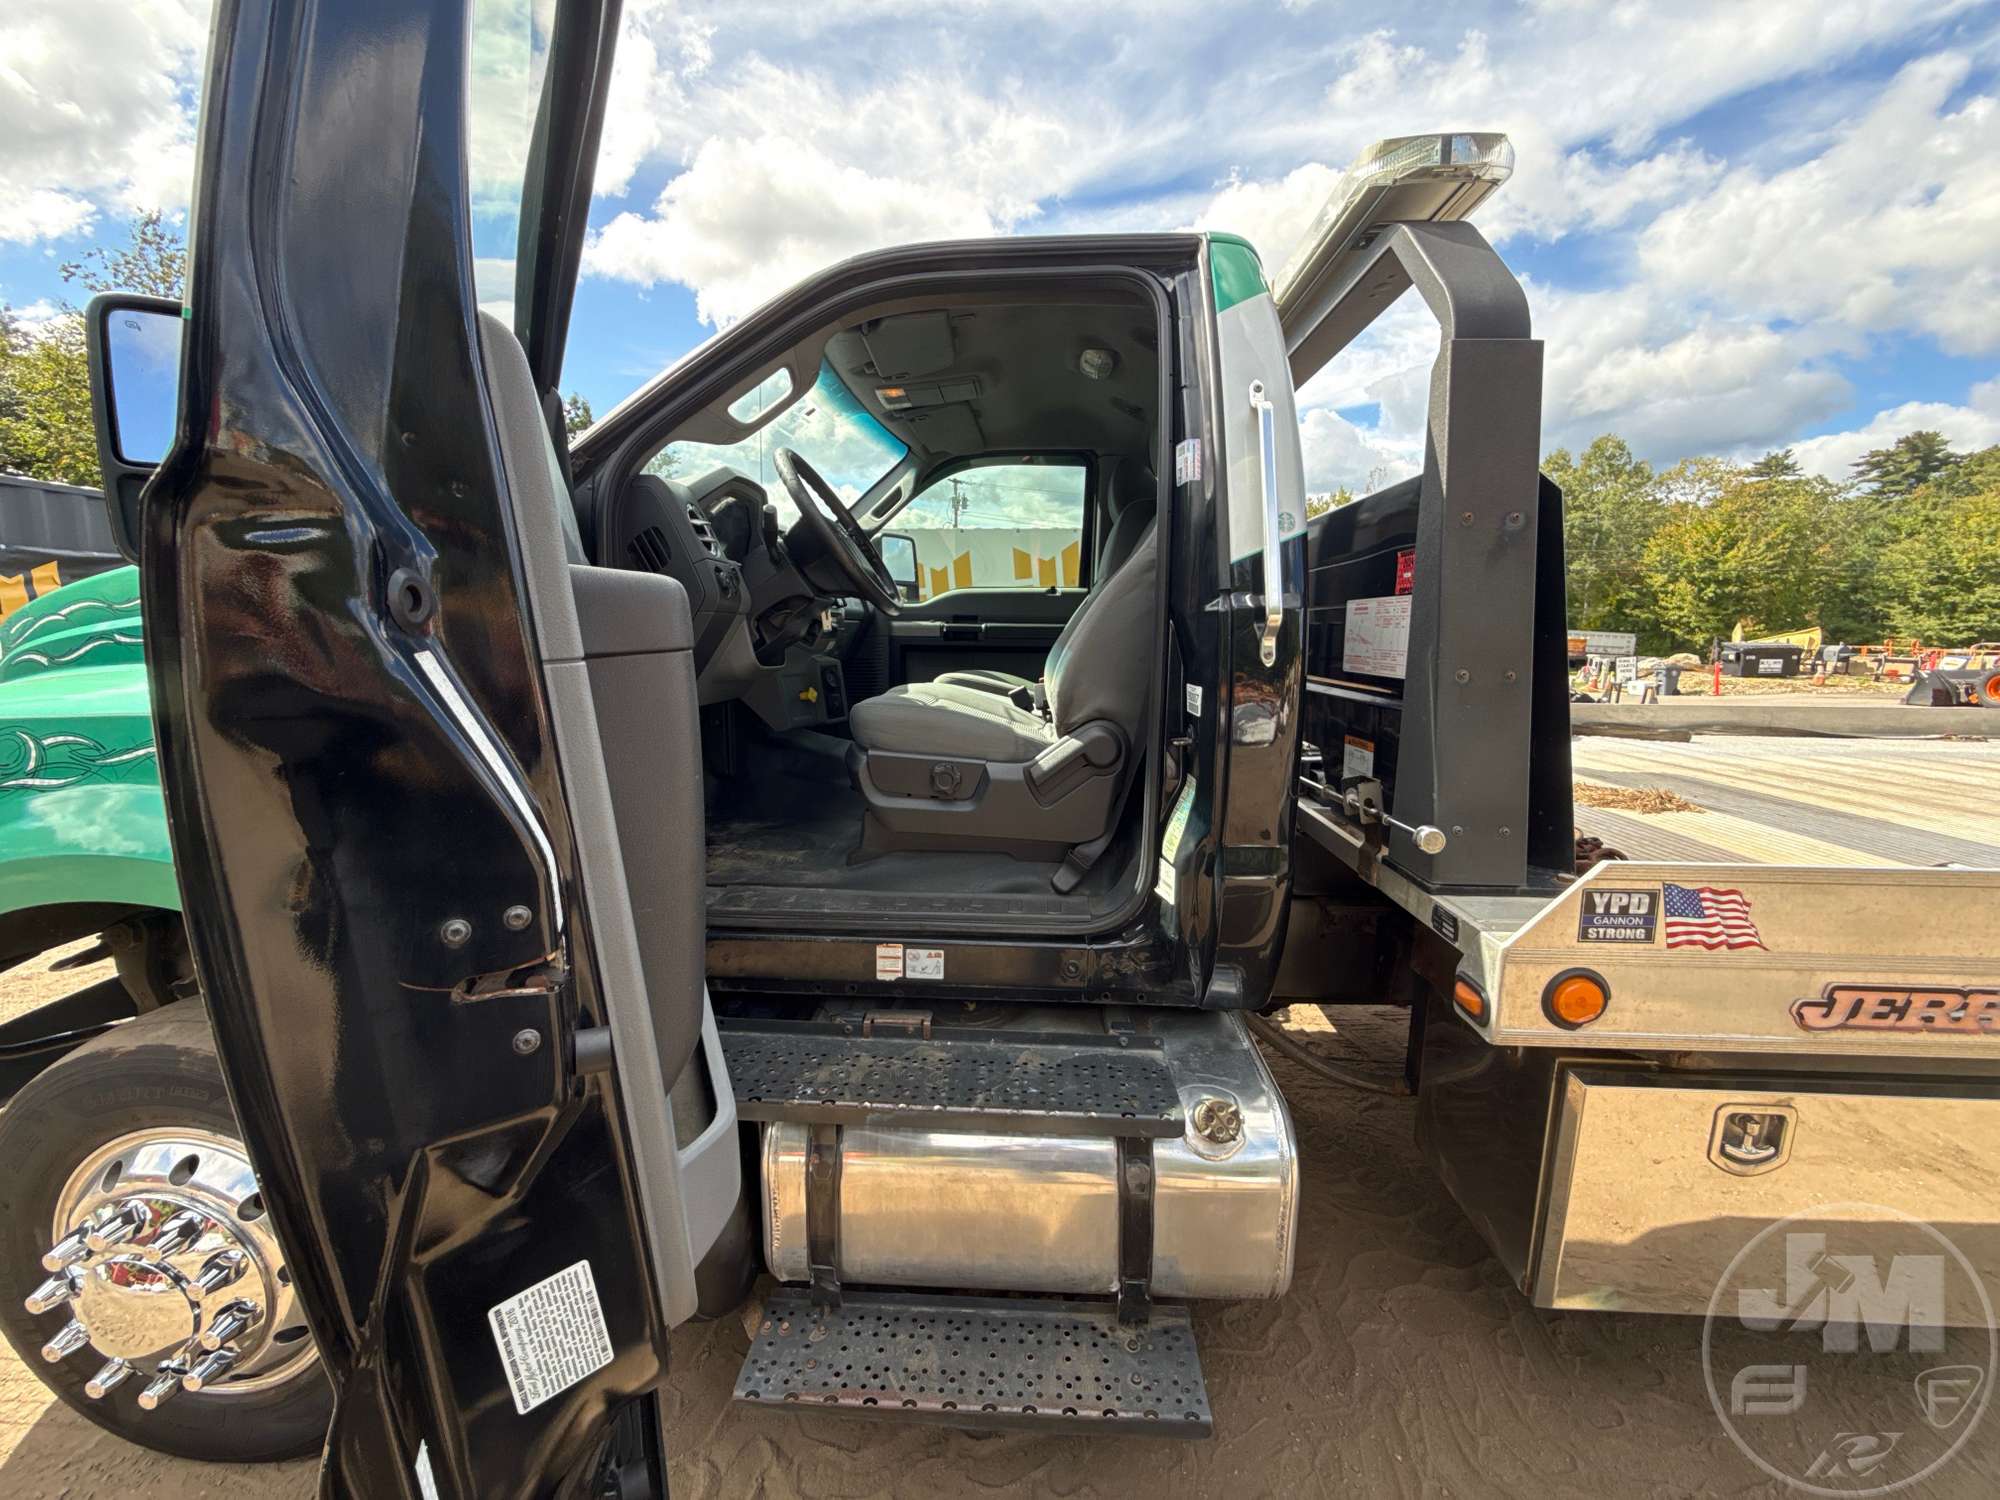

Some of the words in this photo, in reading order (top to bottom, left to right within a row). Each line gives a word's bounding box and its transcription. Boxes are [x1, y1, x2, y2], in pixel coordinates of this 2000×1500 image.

[1592, 892, 1650, 914] YPD
[1593, 916, 1644, 926] GANNON
[1587, 927, 1646, 939] STRONG
